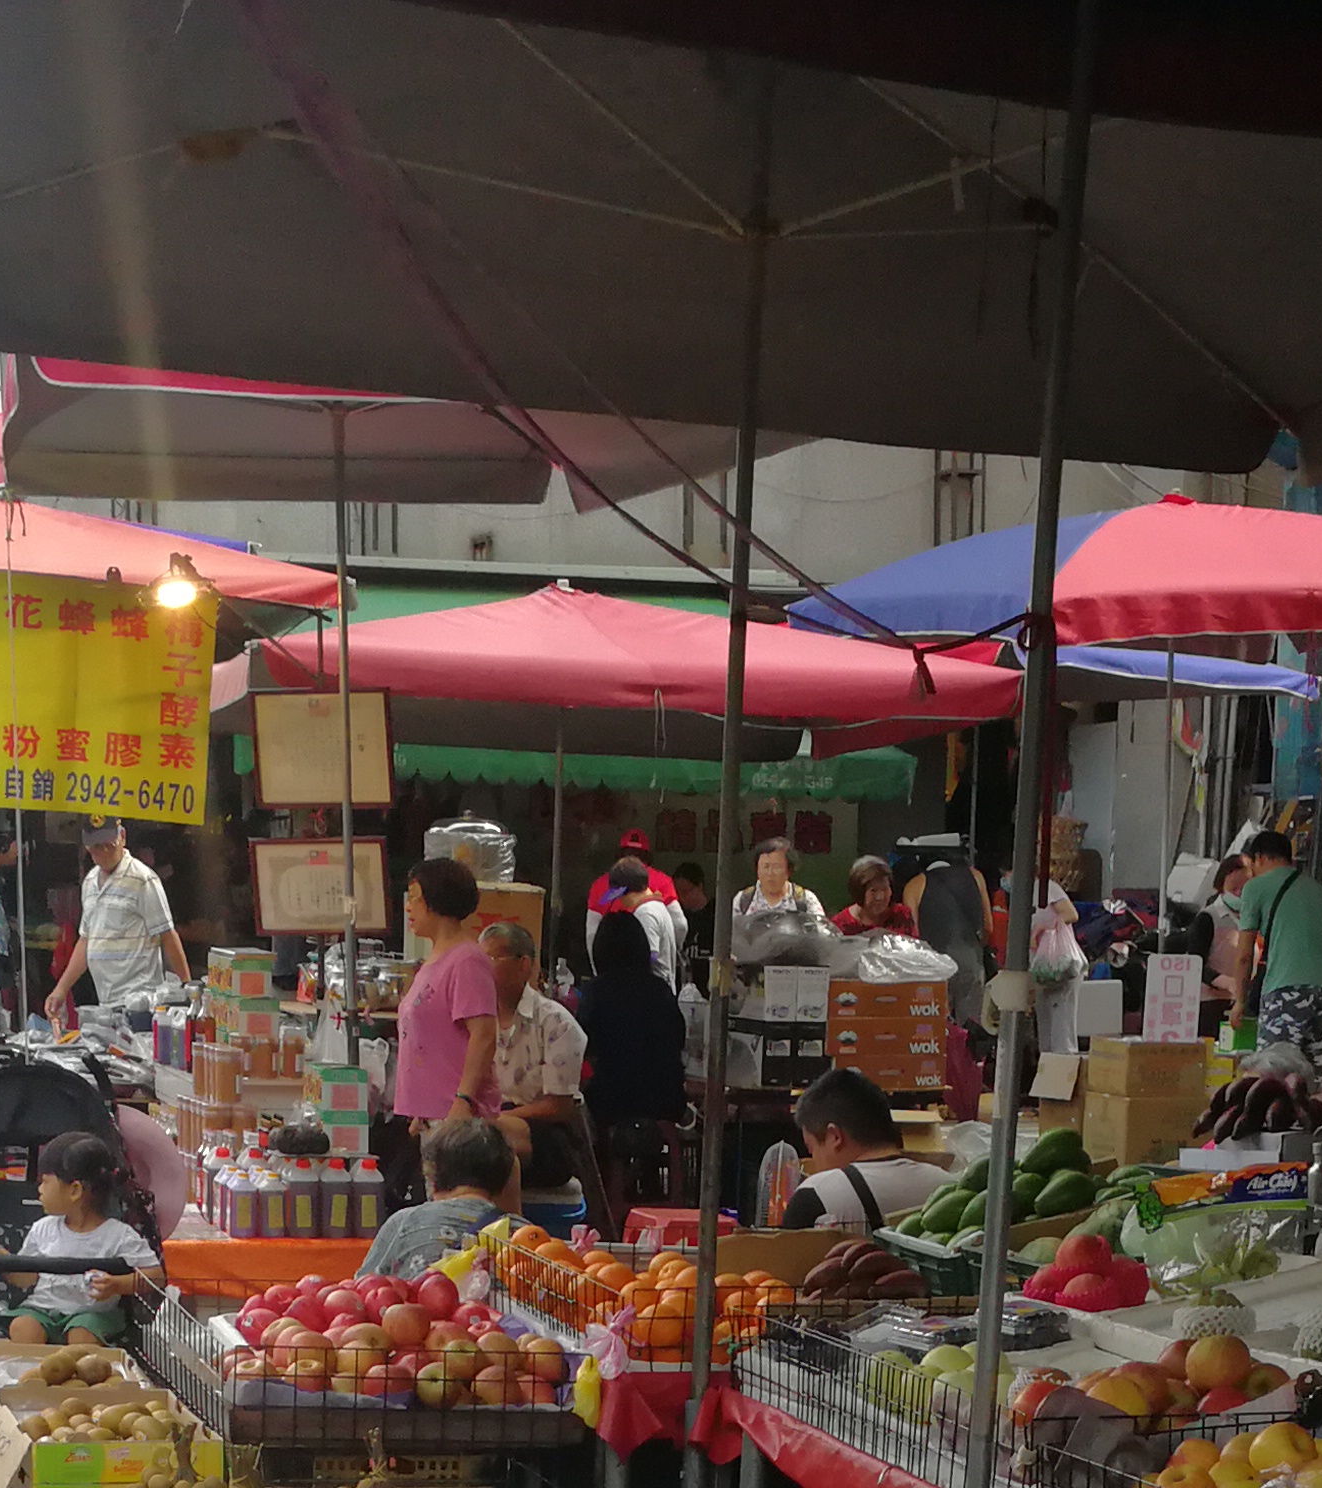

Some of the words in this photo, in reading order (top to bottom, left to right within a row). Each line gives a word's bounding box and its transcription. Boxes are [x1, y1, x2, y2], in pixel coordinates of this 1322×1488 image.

[3, 596, 44, 759] 花粉
[56, 599, 97, 763] 蜂蜜
[104, 603, 150, 768] 蜂膠
[159, 612, 205, 769] 梅子酵素
[66, 772, 195, 814] 2942-6470
[910, 1002, 940, 1017] wok
[909, 1039, 940, 1054] wok
[915, 1075, 941, 1086] wok
[1246, 1176, 1268, 1190] Air
